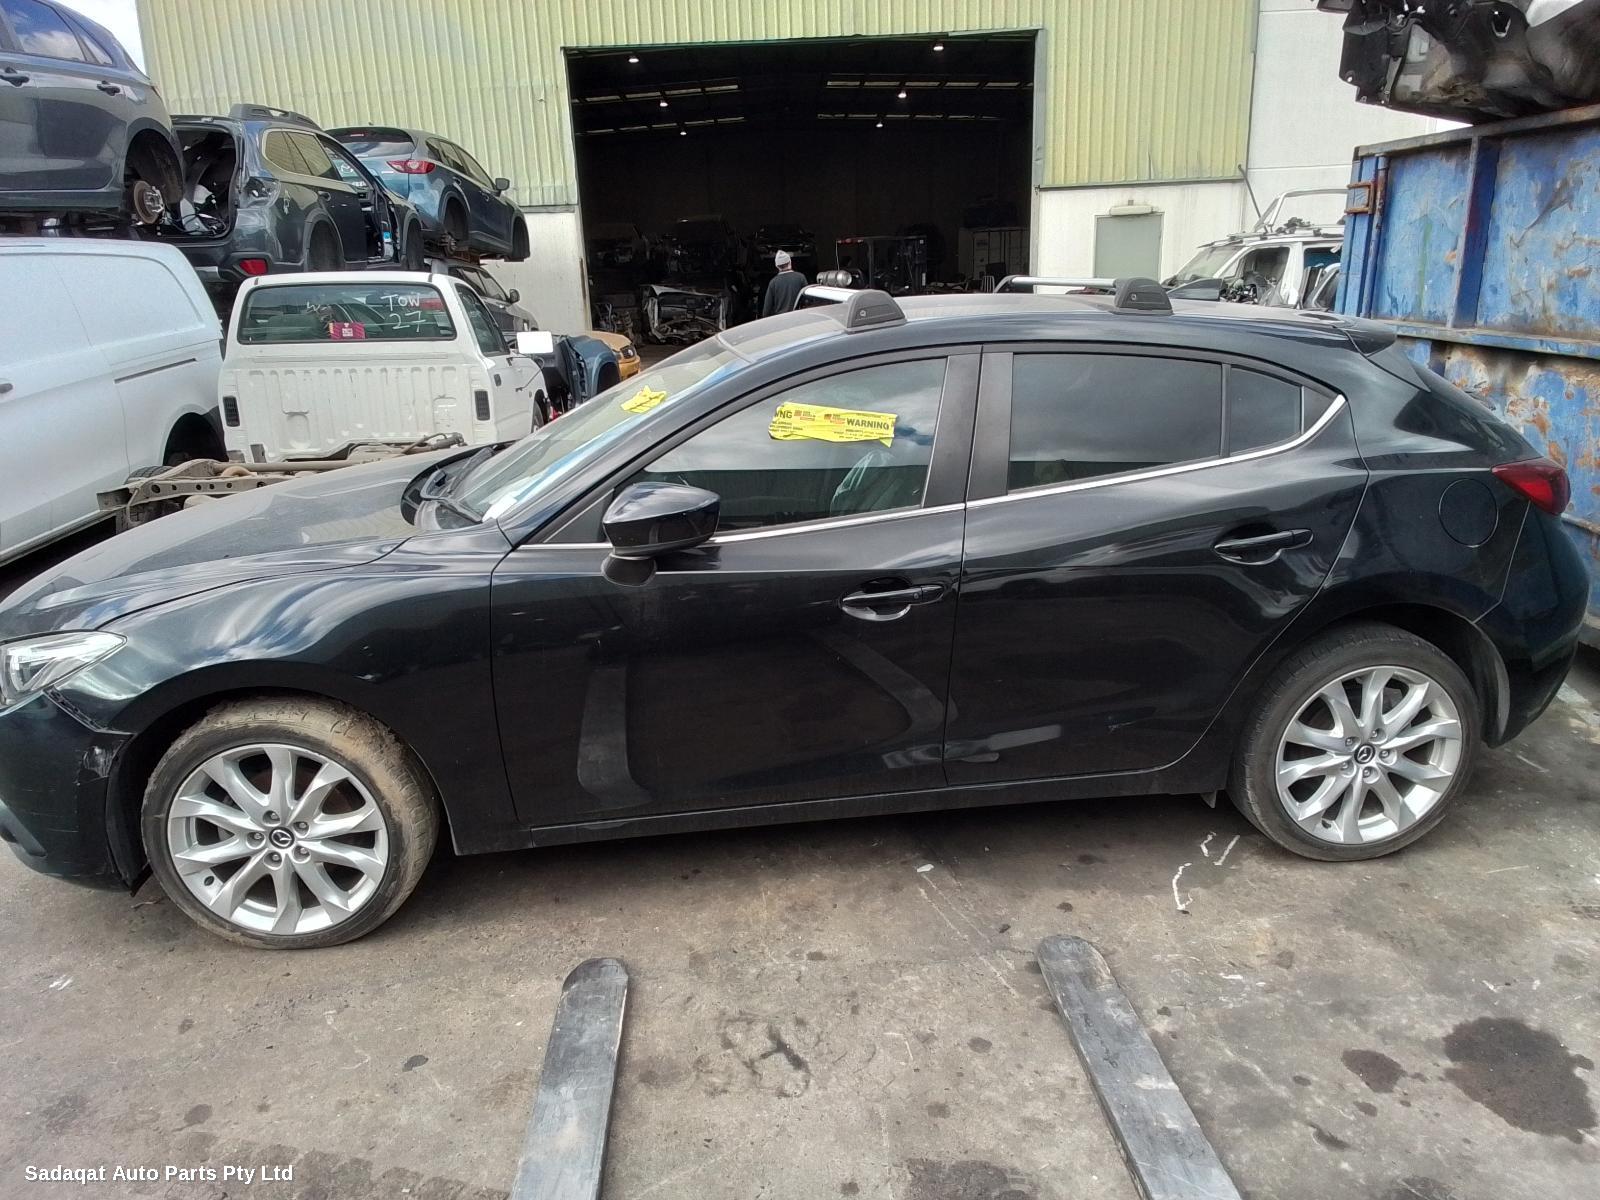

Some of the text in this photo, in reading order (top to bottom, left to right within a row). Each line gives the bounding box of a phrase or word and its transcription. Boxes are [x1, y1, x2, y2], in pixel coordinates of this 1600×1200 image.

[380, 293, 421, 311] TOW
[389, 310, 427, 333] 27
[846, 417, 890, 431] WARNING
